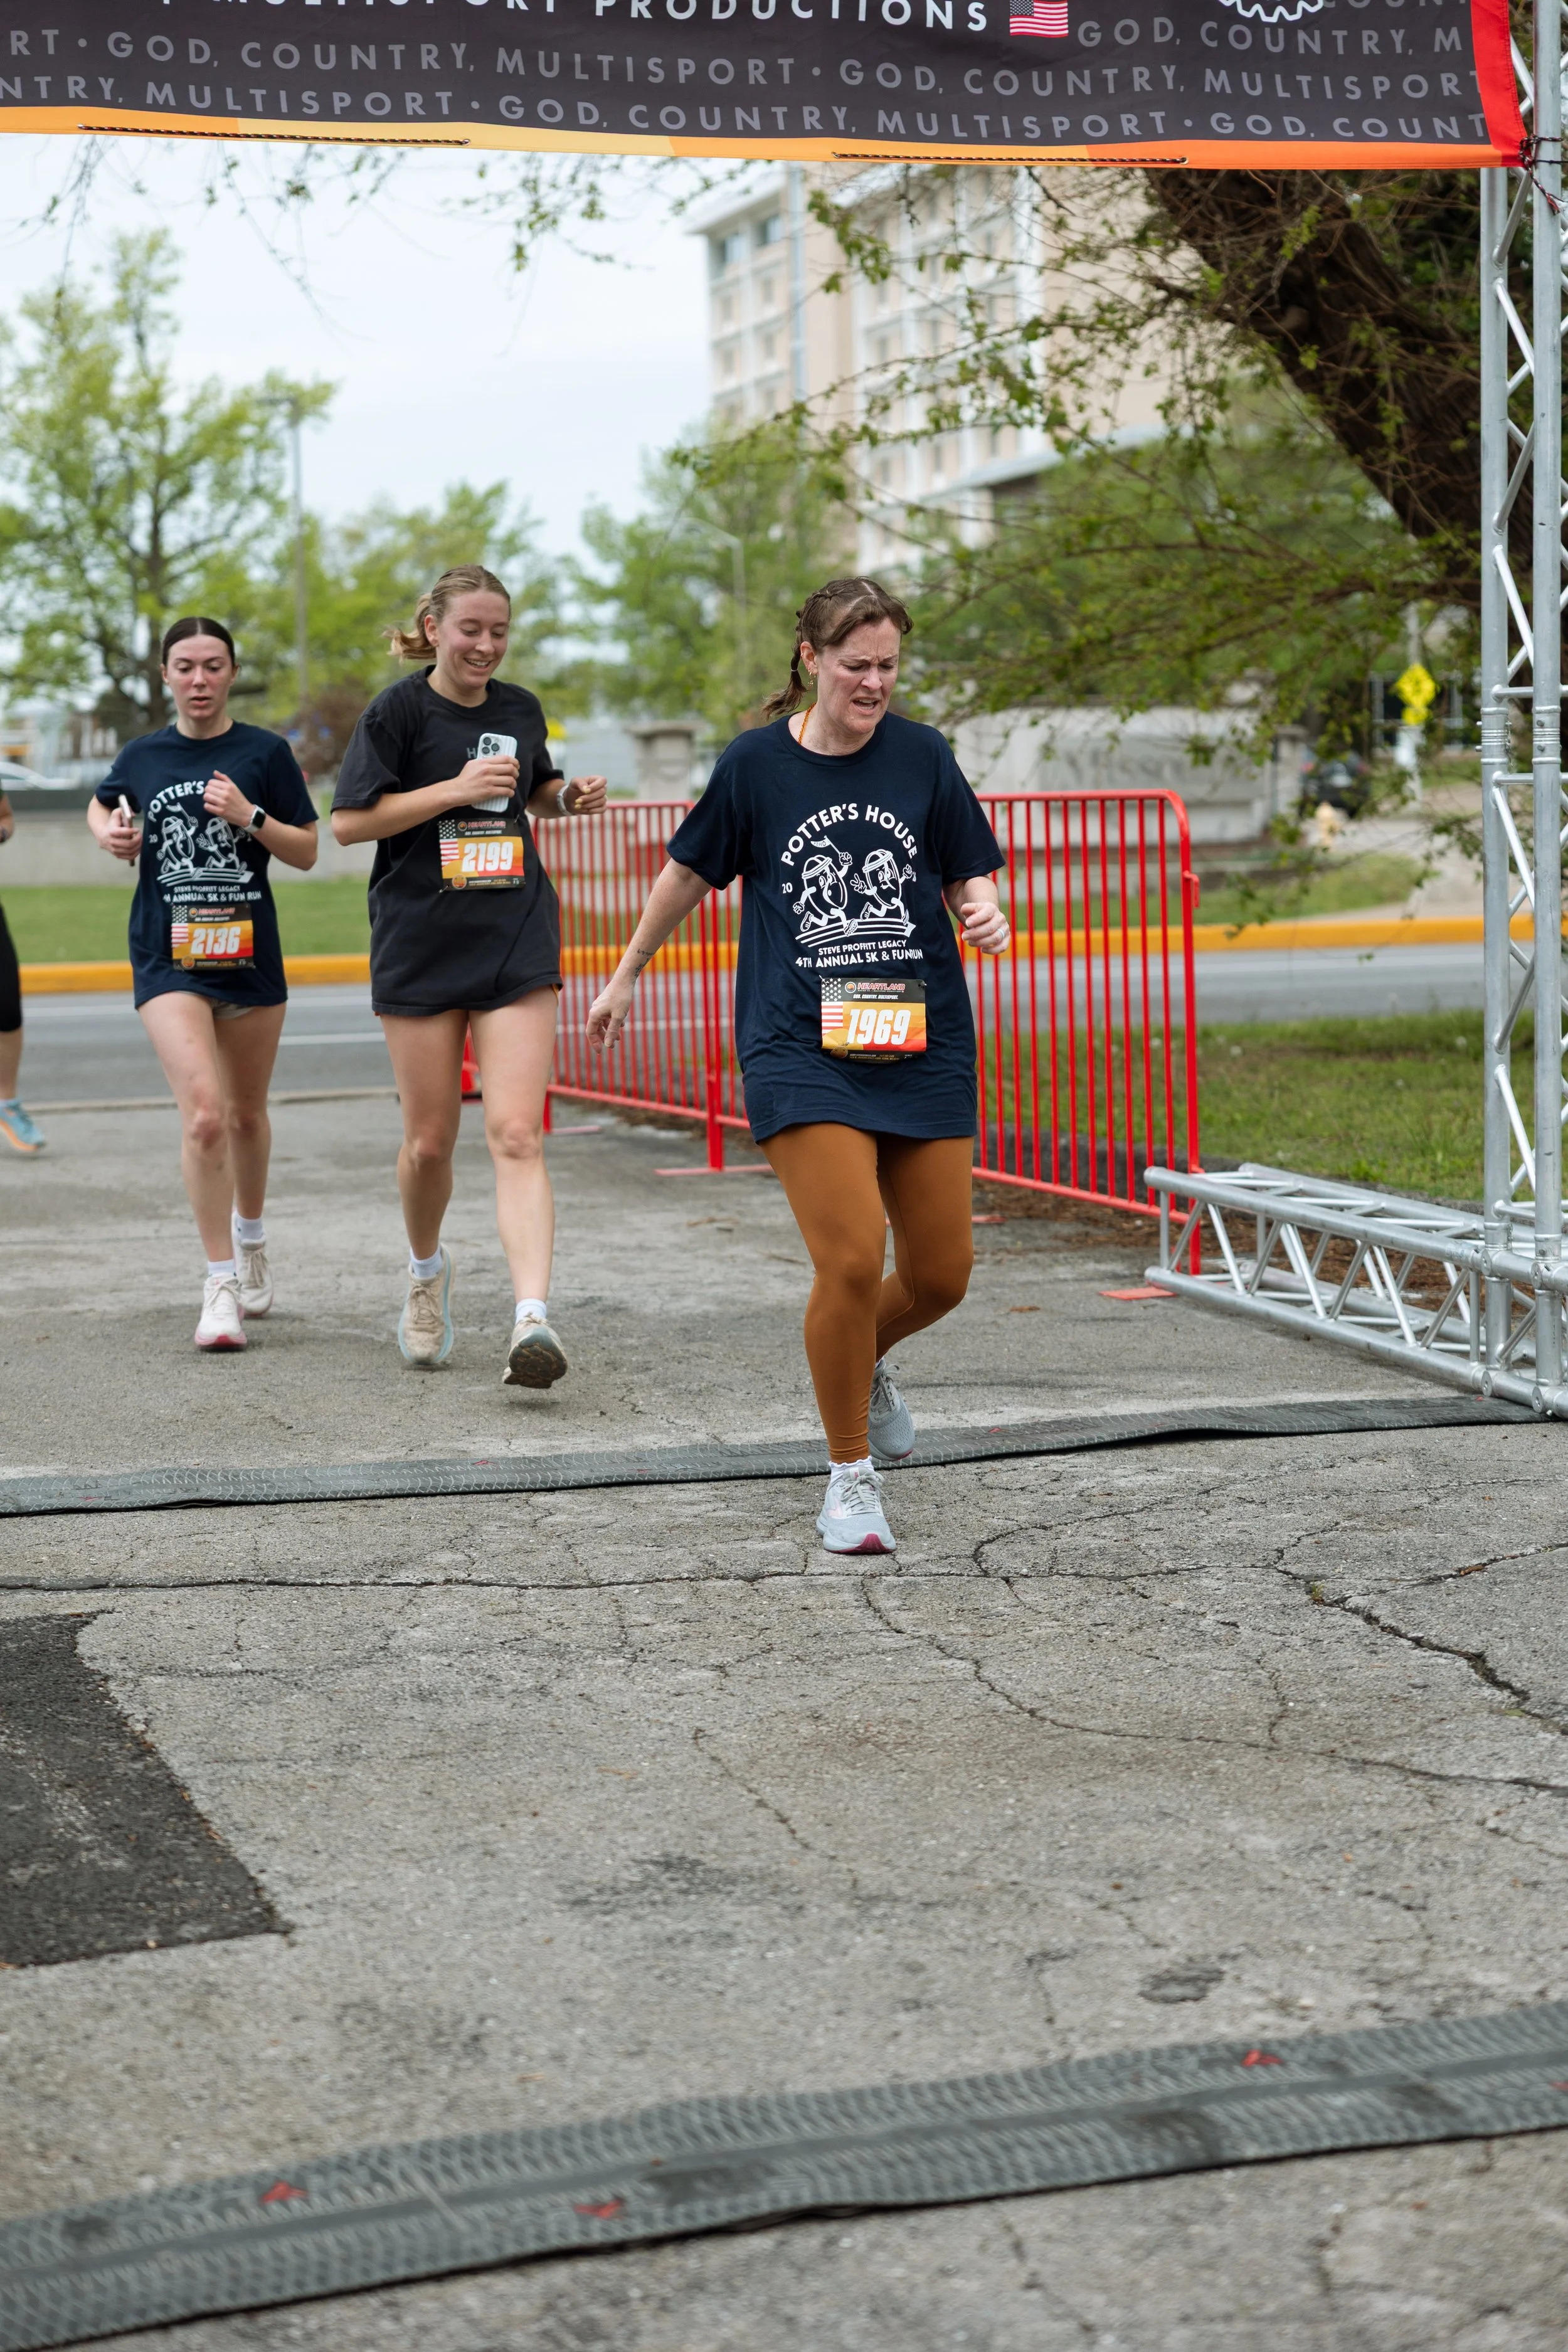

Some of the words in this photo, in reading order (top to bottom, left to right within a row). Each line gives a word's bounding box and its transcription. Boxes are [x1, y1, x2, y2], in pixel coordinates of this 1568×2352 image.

[596, 0, 987, 32] PRODUCTIONS
[1078, 18, 1180, 47] GOD,
[1201, 21, 1414, 55] COUNTRY,
[107, 32, 218, 68] GOD,
[241, 42, 474, 72] COUNTRY,
[497, 48, 794, 85] MULTISPORT
[839, 60, 943, 94] GOD,
[963, 65, 1185, 97] COUNTRY,
[146, 82, 453, 116] MULTISPORT
[499, 95, 608, 127] GOD,
[628, 105, 856, 133] COUNTRY,
[877, 110, 1166, 139] MULTISPORT
[147, 780, 205, 822] POTTER'S
[781, 803, 859, 866] POTTER'S
[865, 804, 918, 860] HOUSE
[461, 842, 514, 872] 2199
[228, 893, 246, 901] FUN
[246, 891, 262, 900] RUN
[781, 882, 793, 894] 20
[191, 926, 241, 955] 2136
[818, 946, 841, 955] STEVE
[842, 942, 876, 952] PROFFITT
[878, 940, 907, 949] LEGACY
[795, 956, 813, 968] 4TH
[815, 952, 864, 968] ANNUAL
[866, 951, 879, 963] 5K
[881, 951, 890, 961] &
[857, 982, 906, 991] HEARTLAND
[847, 1009, 911, 1046] 1969
